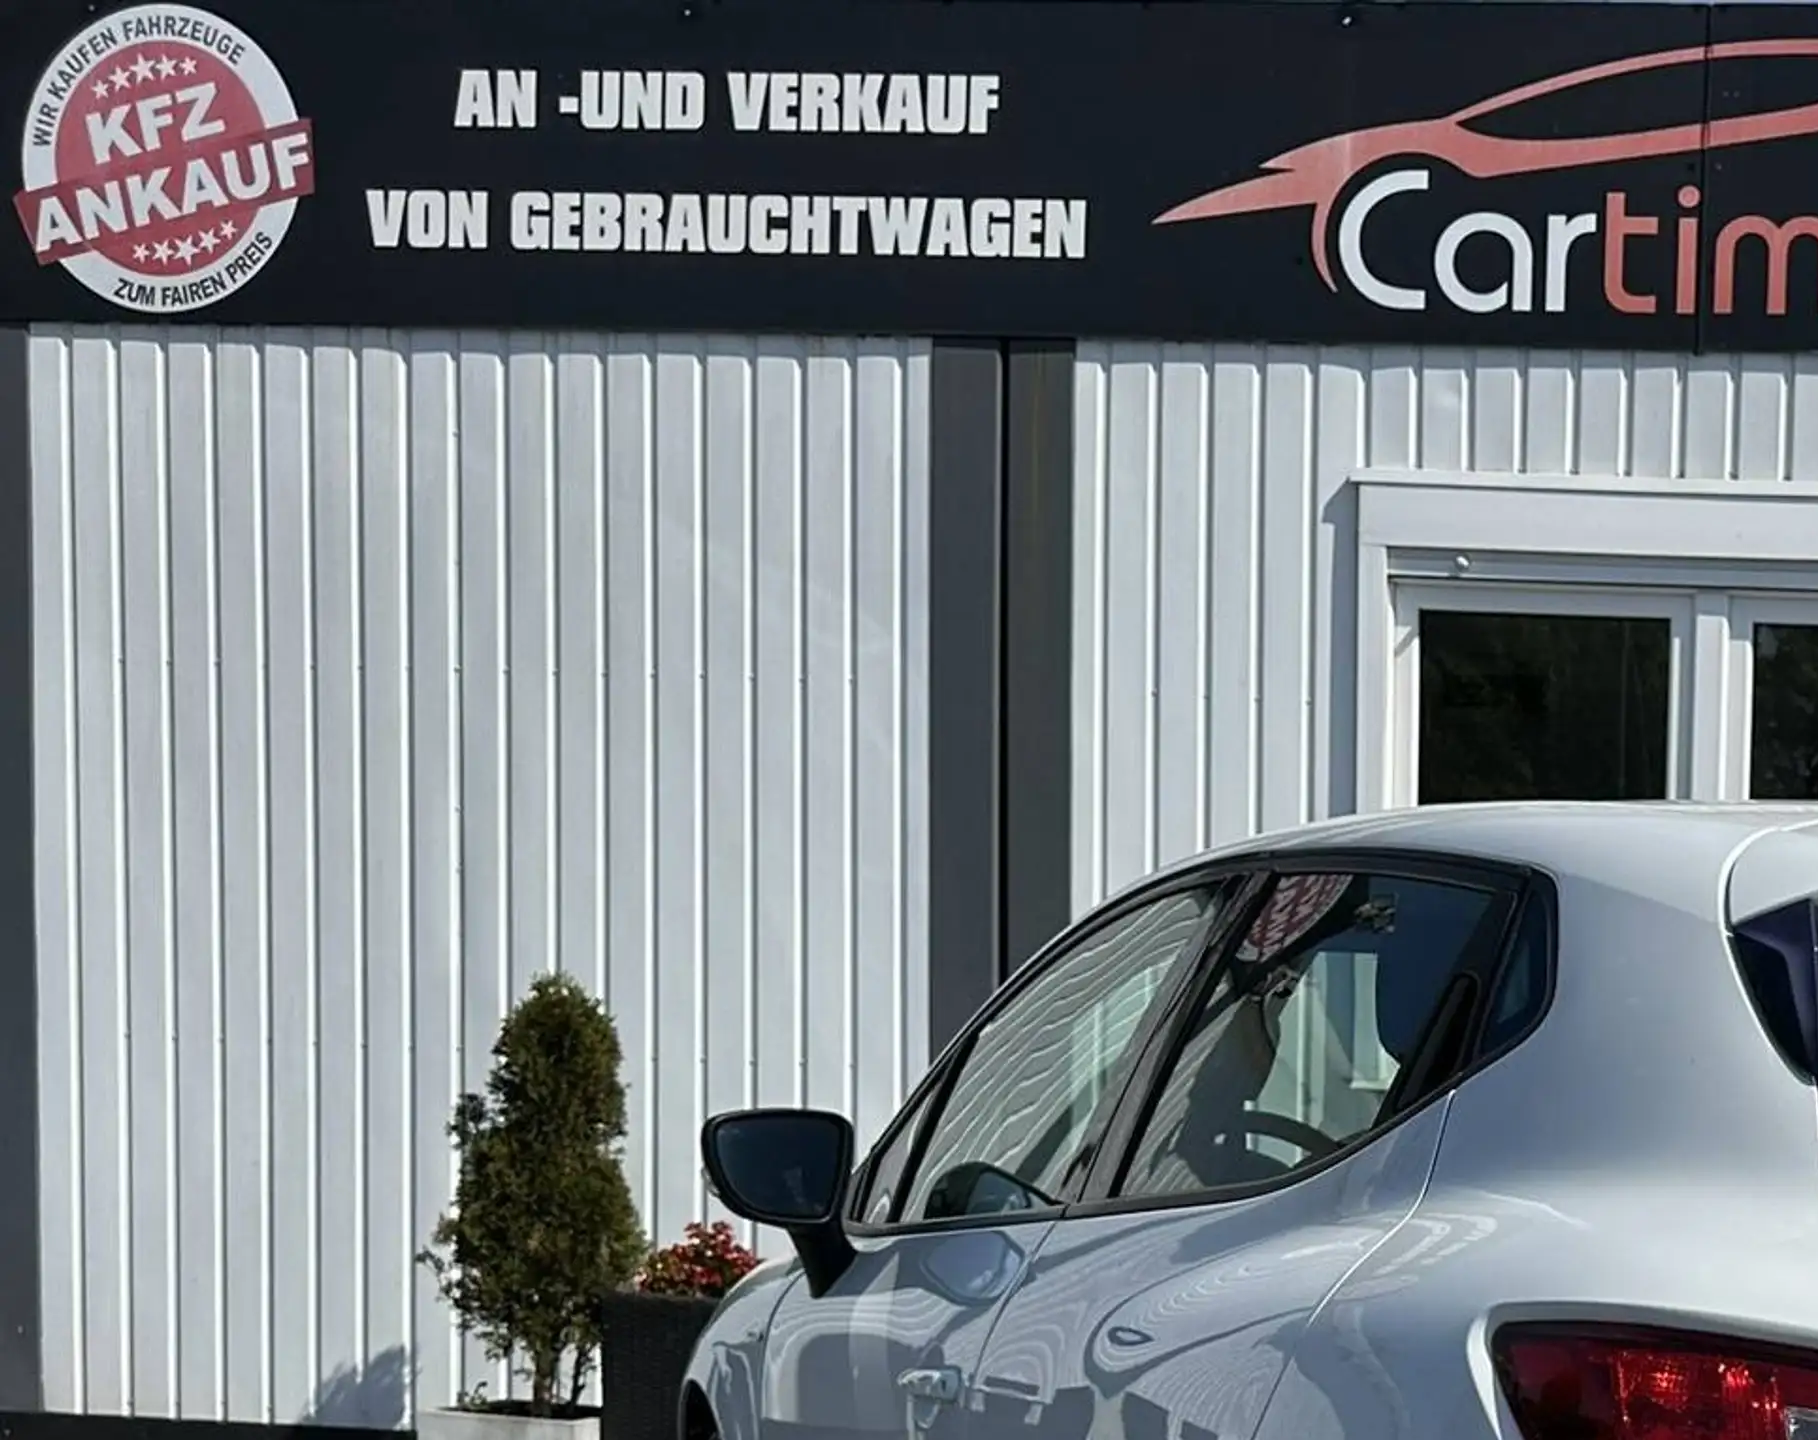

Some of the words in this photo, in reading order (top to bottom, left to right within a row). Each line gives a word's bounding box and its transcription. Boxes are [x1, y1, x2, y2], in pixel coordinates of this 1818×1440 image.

[33, 103, 58, 147] WIR
[47, 28, 117, 101] KAUFEN
[122, 15, 246, 65] FAHRZEUGE
[455, 70, 536, 128] AN
[728, 72, 1000, 134] VERKAUF
[85, 82, 226, 165] KFZ
[35, 132, 309, 253] ANKAUF
[365, 189, 489, 249] VON
[510, 191, 1087, 259] GEBRAUCHTWAGEN
[113, 277, 155, 306] ZUM
[161, 271, 227, 307] FAIREN
[228, 231, 273, 284] PREIS
